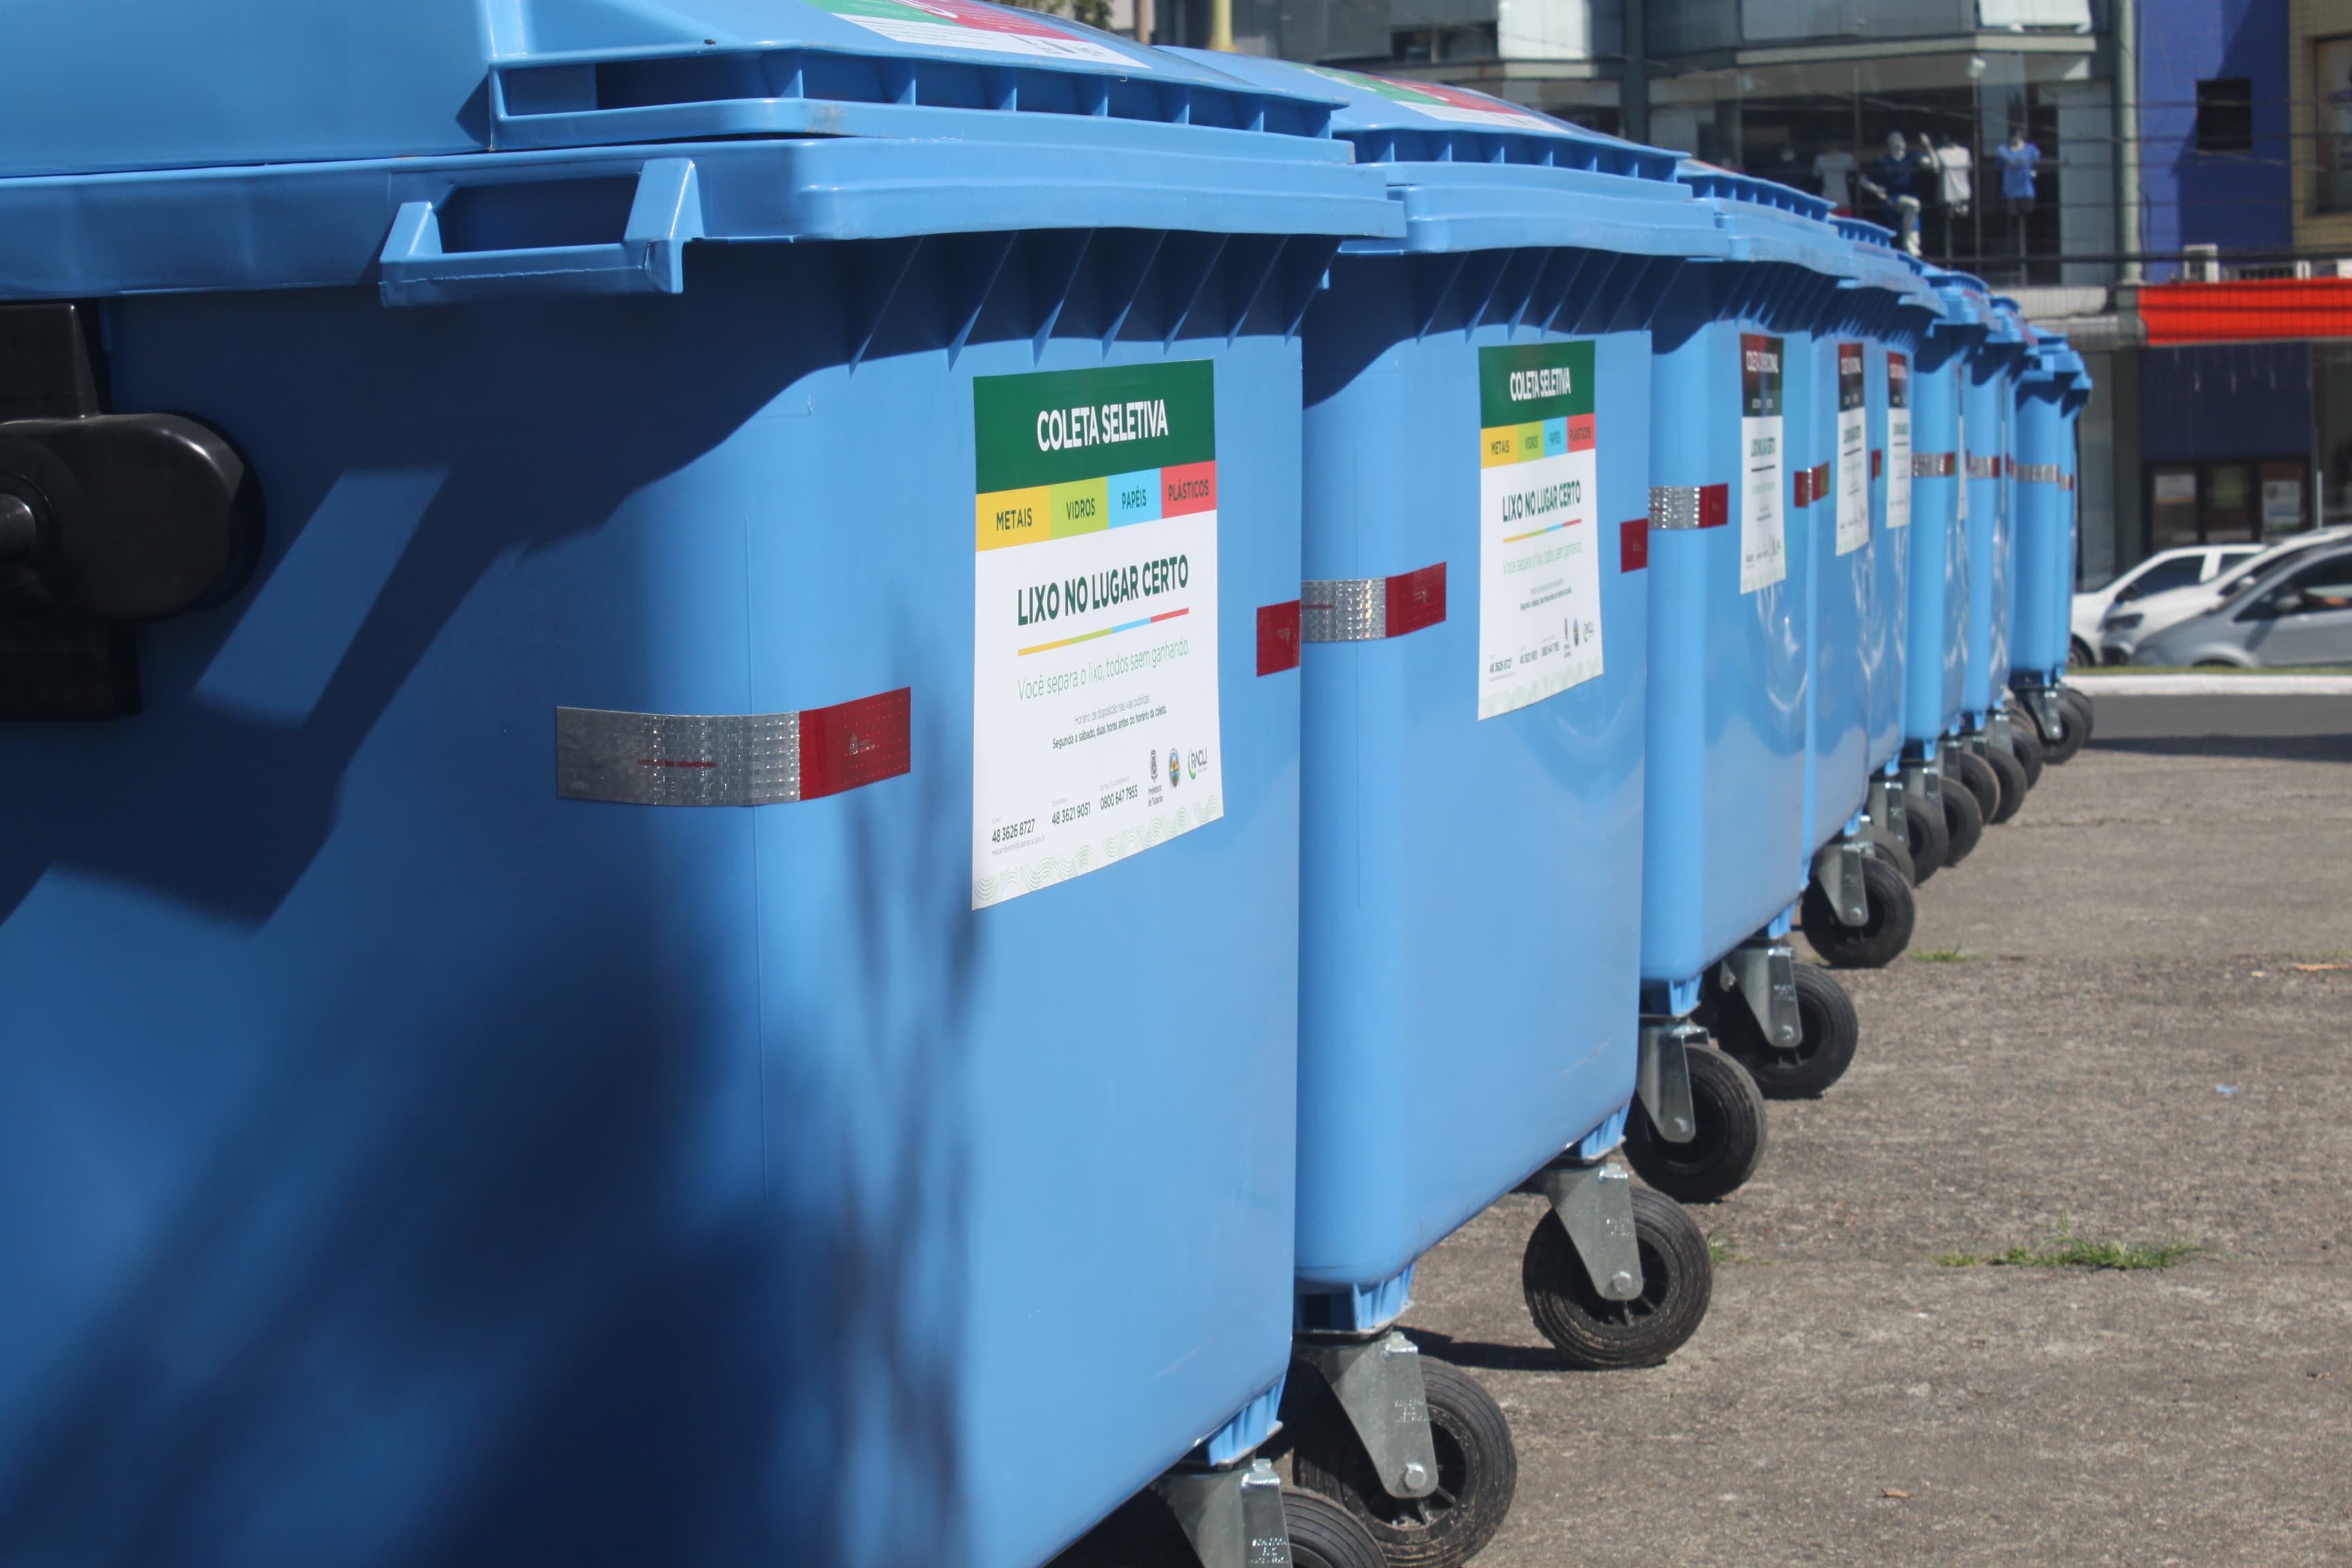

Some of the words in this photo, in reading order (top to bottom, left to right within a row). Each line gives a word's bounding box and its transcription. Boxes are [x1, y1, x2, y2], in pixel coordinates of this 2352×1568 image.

[1510, 370, 1539, 402] COLETA
[1539, 368, 1571, 397] SELETIVA
[1037, 406, 1100, 451] COLETA
[1102, 399, 1169, 444] SELETIVA
[1491, 440, 1509, 455] METAIS
[1122, 485, 1147, 510] PAPÉIS
[1168, 479, 1209, 502] PLÁSTICOS
[1503, 493, 1523, 523] LIXO
[1524, 490, 1536, 517] NO
[1537, 485, 1558, 514] LUGAR
[1559, 480, 1581, 508] CERTO
[996, 508, 1032, 531] METAIS
[1066, 498, 1095, 520] VIDROS
[1018, 582, 1060, 626] LIXO
[1065, 576, 1088, 616] NO
[1092, 565, 1139, 610] LUGAR
[1142, 554, 1188, 596] CERTO
[1017, 674, 1045, 701] Você
[1047, 670, 1078, 697] separa
[1081, 668, 1087, 685] o
[1088, 662, 1105, 683] lixo,
[1106, 653, 1129, 678] todos
[1130, 651, 1150, 670] saem
[1152, 636, 1191, 668] ganhando.
[1052, 733, 1074, 749] Segunda
[1075, 734, 1078, 743] a
[1096, 725, 1106, 736] duas
[1106, 721, 1117, 732] horas
[1118, 718, 1129, 729] antes
[1100, 793, 1114, 810] 0800
[1115, 789, 1124, 804] 647
[1126, 784, 1138, 800] 7955
[1051, 811, 1060, 826] 48
[1062, 806, 1076, 823] 3621
[1077, 801, 1090, 818] 9051
[992, 829, 1000, 844] 48
[1002, 823, 1018, 841] 3626
[1019, 818, 1035, 836] 8727
